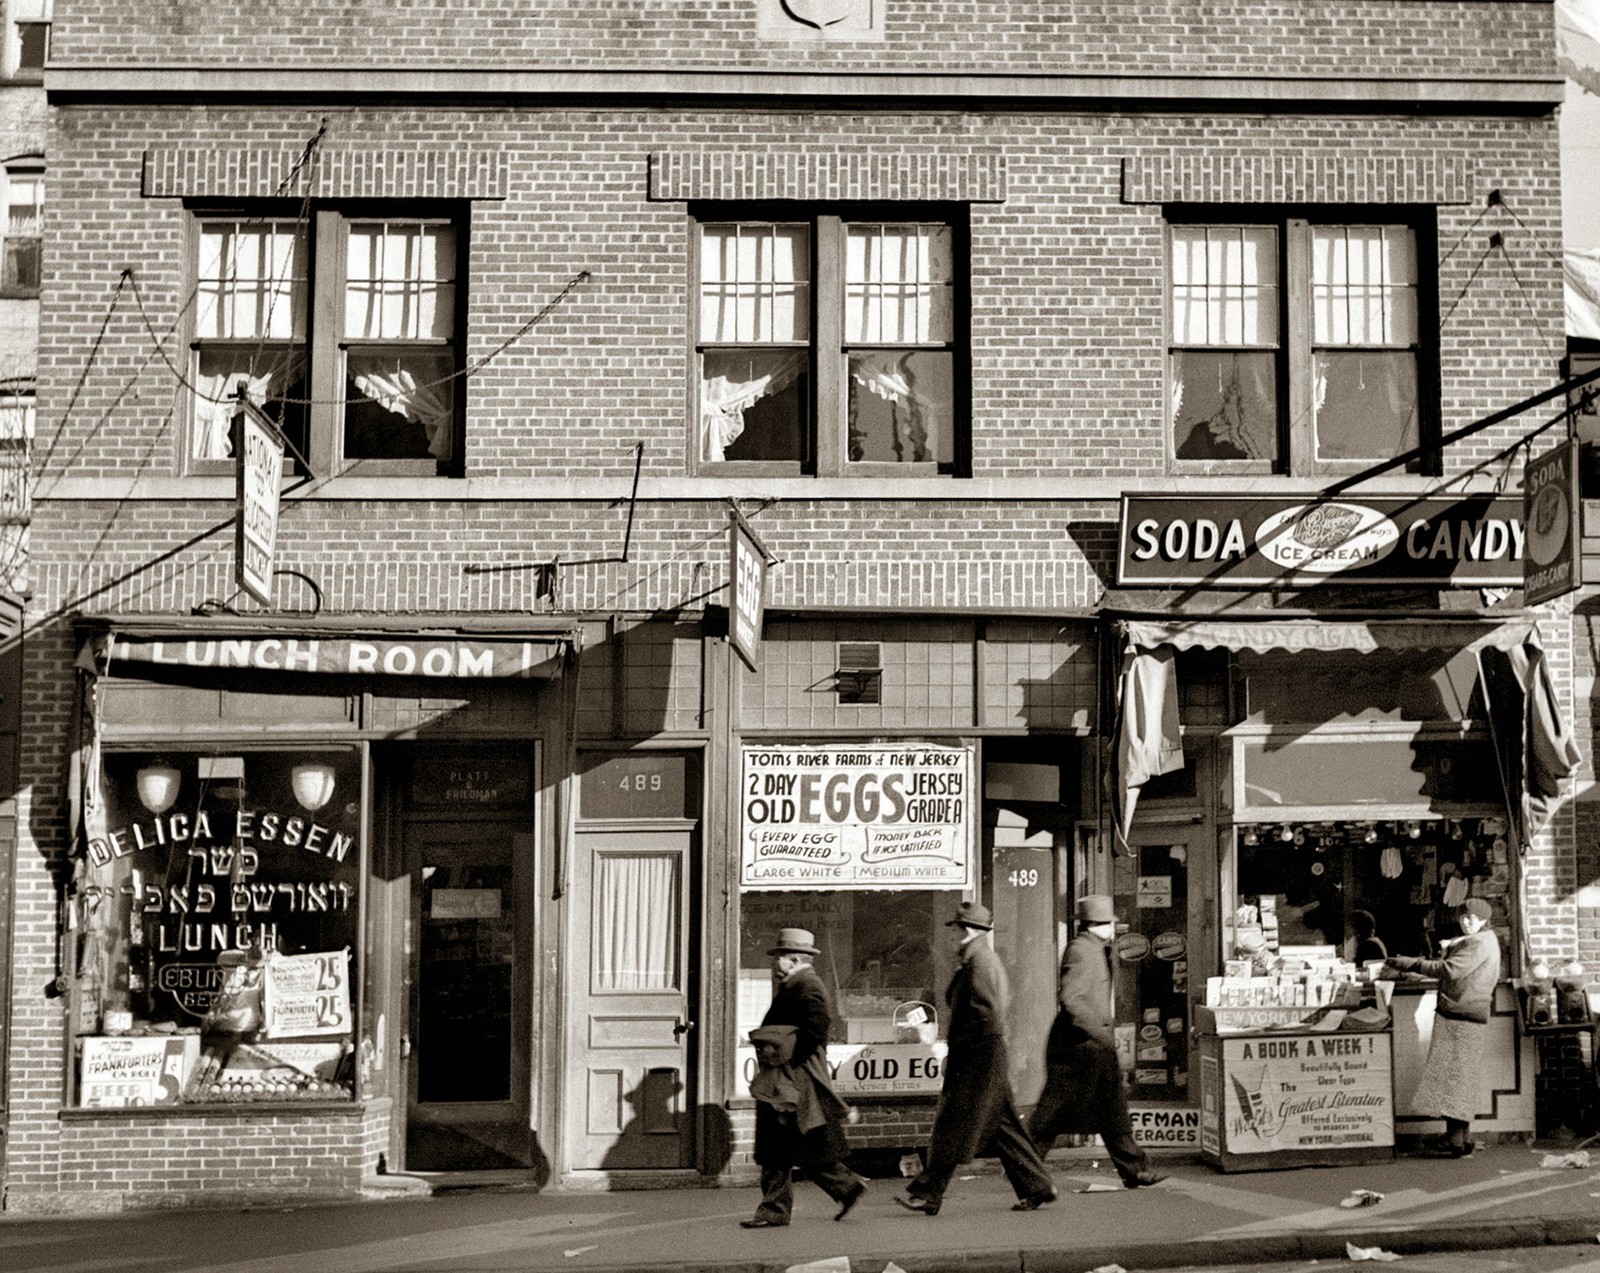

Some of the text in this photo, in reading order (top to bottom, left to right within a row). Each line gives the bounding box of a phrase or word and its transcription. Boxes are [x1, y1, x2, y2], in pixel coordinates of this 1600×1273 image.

[1530, 457, 1566, 496] SODA
[1135, 518, 1247, 560] SODA
[1406, 518, 1526, 560] CANDY
[1273, 544, 1379, 560] ICE CREAM
[153, 637, 493, 678] LUNCH ROOM
[748, 753, 792, 766] TOMS
[796, 753, 830, 766] RIVER
[835, 753, 872, 766] FARMS
[889, 753, 916, 766] NEW
[918, 753, 962, 766] JERSEY
[449, 770, 491, 782] PLATT
[619, 774, 662, 791] 489
[748, 773, 798, 796] 2 DAY
[905, 772, 963, 796] JERSEY
[799, 773, 906, 824] EGGS
[747, 799, 796, 824] OLD
[907, 799, 963, 824] GRADE A
[761, 831, 838, 844] EVERY EGG
[874, 829, 943, 842] MONEY BACK
[759, 846, 832, 858] GUARANTEED
[880, 844, 897, 854] NOT
[899, 840, 943, 854] SATISFIED
[753, 866, 842, 878] LARGE WHITE
[859, 866, 947, 877] MEDIUM WHITE
[1008, 868, 1039, 888] 489
[158, 922, 278, 953] LUNCH
[1248, 1010, 1289, 1025] YORK
[1242, 1043, 1253, 1060] A
[1258, 1041, 1299, 1059] BOOK
[1306, 1040, 1317, 1057] A
[1321, 1038, 1362, 1056] WEEK
[88, 1052, 163, 1075] FRANKFURTERS
[854, 1058, 900, 1081] OLD
[1300, 1061, 1368, 1073] Beautifully Bound
[1280, 1082, 1297, 1092] The
[1339, 1074, 1356, 1086] Type
[1278, 1094, 1327, 1120] Greatest
[1326, 1091, 1387, 1110] Literature
[1300, 1114, 1330, 1125] Offered
[1298, 1135, 1314, 1145] NEW
[1314, 1135, 1333, 1145] YORK
[1342, 1133, 1374, 1144] JOURNAL
